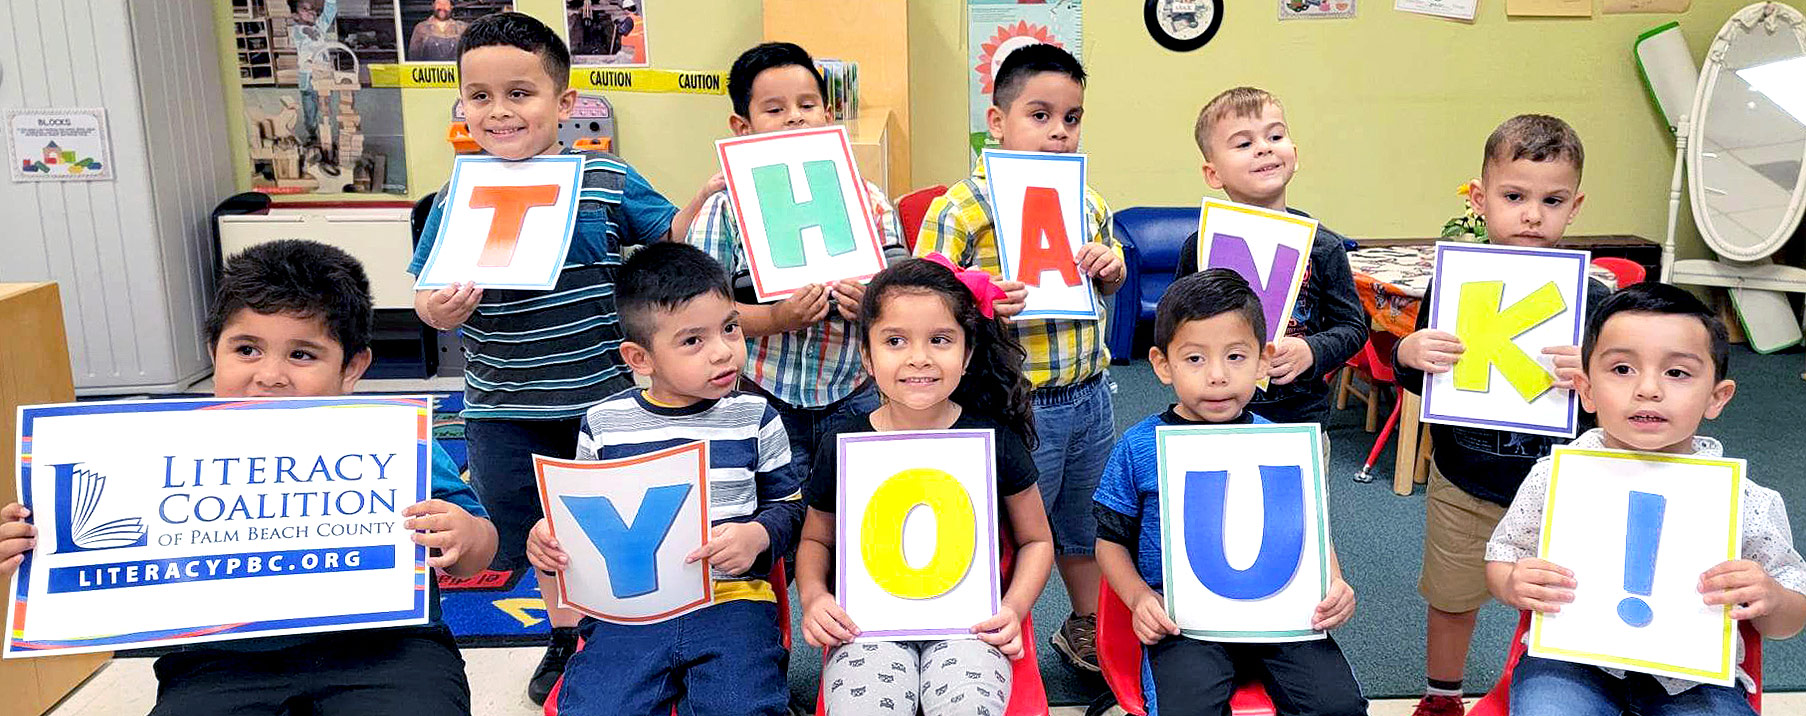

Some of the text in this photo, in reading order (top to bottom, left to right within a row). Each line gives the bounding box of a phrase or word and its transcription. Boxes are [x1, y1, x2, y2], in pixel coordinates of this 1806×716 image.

[412, 67, 455, 83] CAUTION
[590, 71, 632, 88] CAUTION
[678, 73, 720, 90] CAUTION
[37, 118, 71, 126] BLOCKS
[468, 183, 561, 269] T
[751, 159, 858, 270] H
[1017, 186, 1083, 289] A
[1207, 232, 1301, 342] N
[1453, 280, 1568, 404] K
[162, 453, 397, 488] LITERACY
[158, 488, 398, 525] COALITION
[158, 521, 396, 547] OF PALM BEACH COUNTY
[860, 468, 978, 600] O
[1183, 465, 1306, 601] U
[79, 550, 362, 588] LITERACYPBC.ORG
[558, 482, 694, 600] Y
